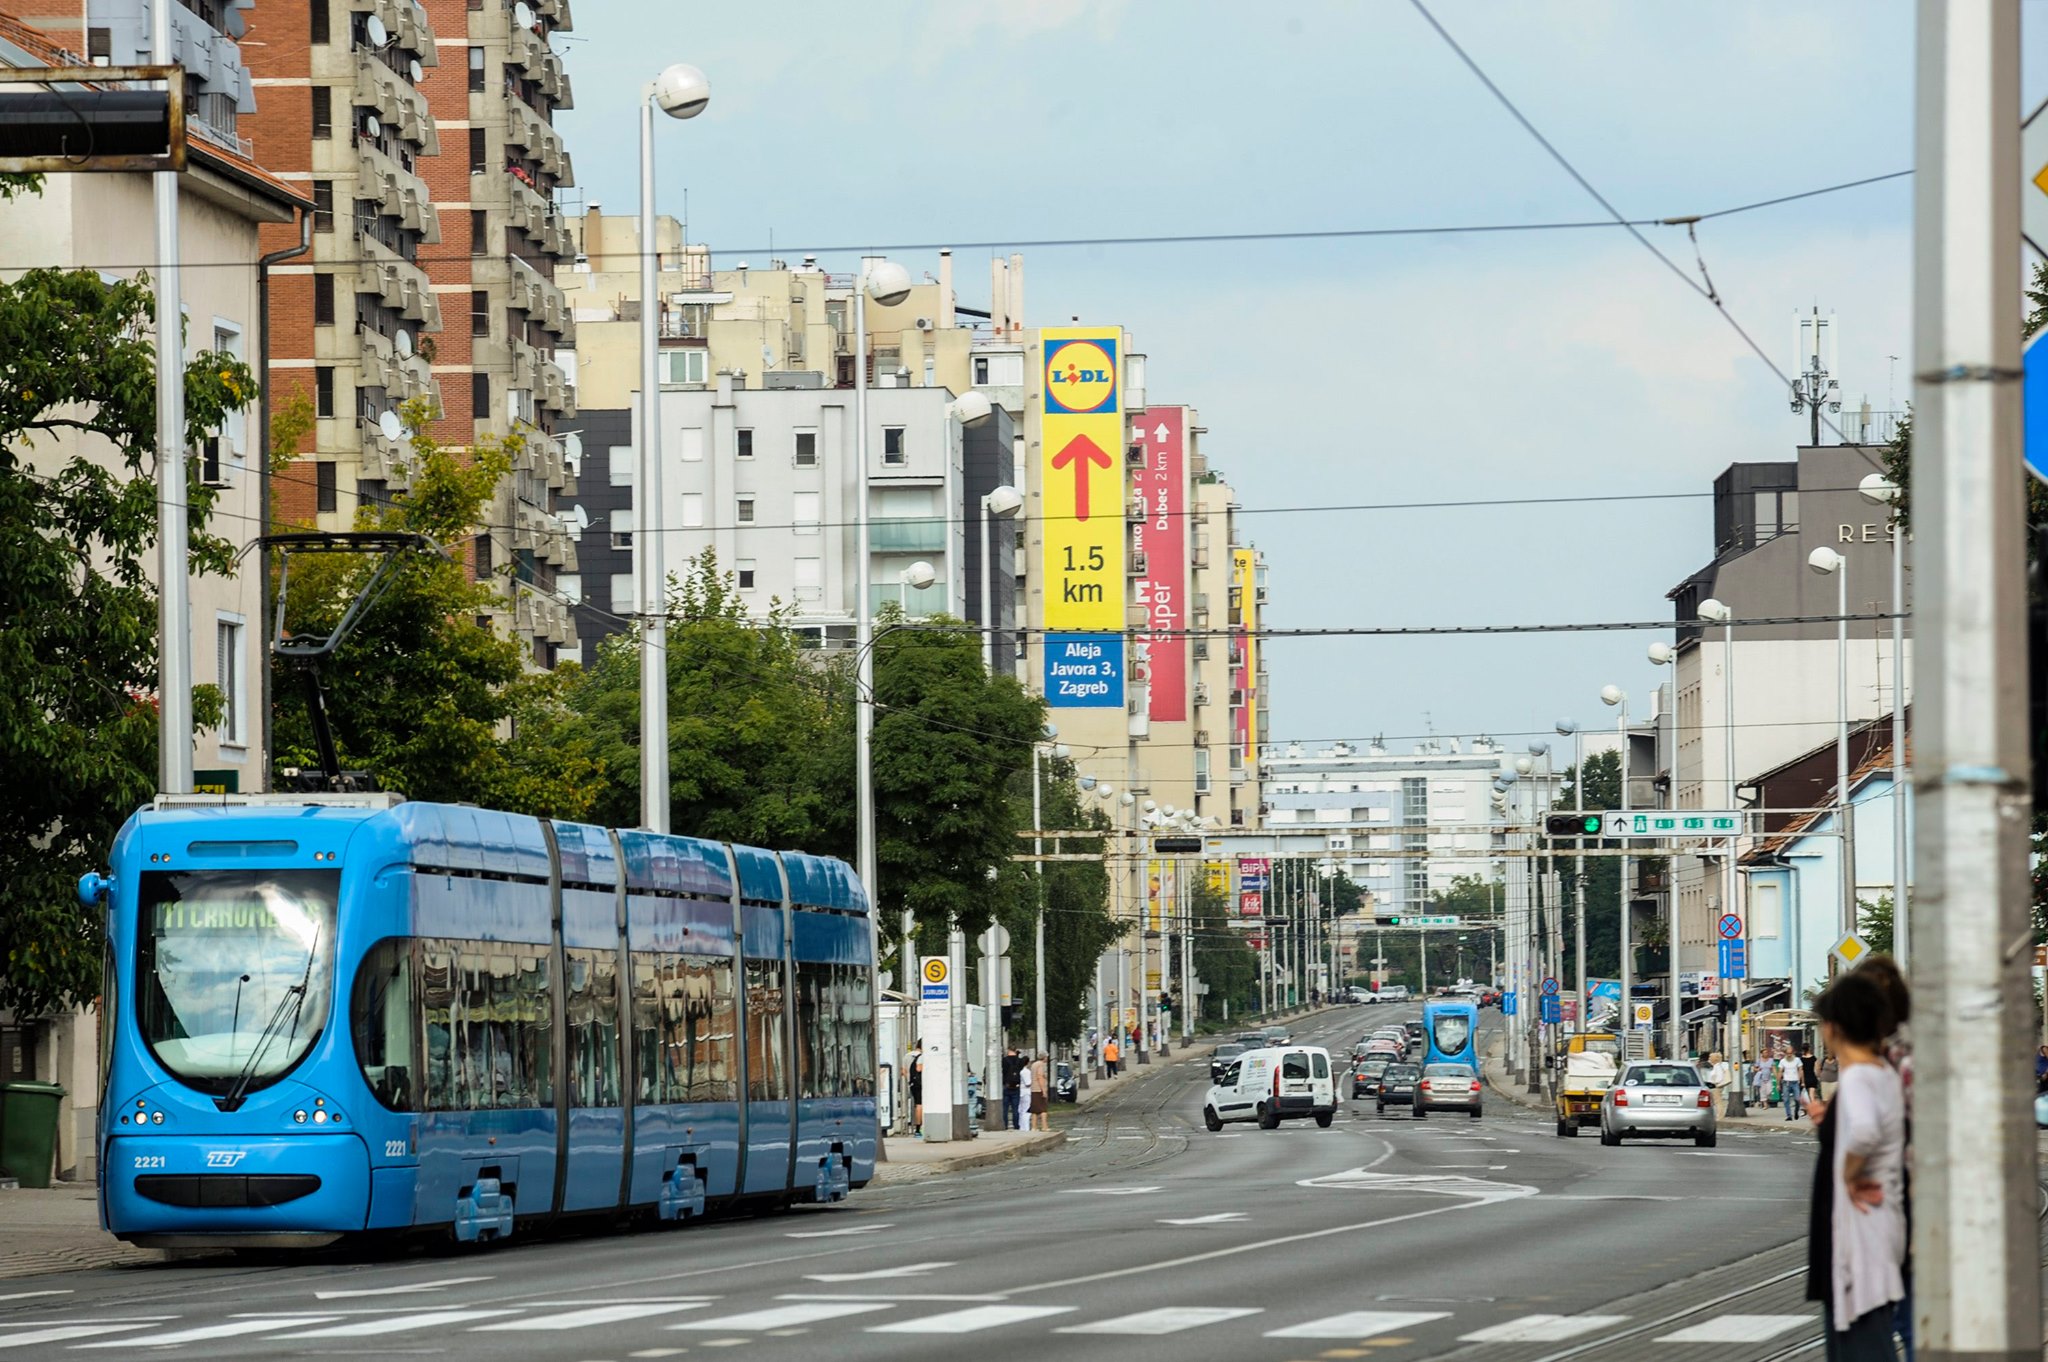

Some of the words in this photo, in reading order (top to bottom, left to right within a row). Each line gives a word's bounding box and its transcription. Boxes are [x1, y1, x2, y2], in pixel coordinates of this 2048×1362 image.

[1154, 452, 1167, 471] km
[1155, 473, 1167, 481] 2
[1155, 488, 1168, 530] Dubec
[1063, 545, 1104, 571] 1.5
[1063, 577, 1103, 603] km
[1154, 581, 1178, 643] super
[1065, 642, 1101, 660] Aleja
[1050, 661, 1097, 676] Javora
[1101, 661, 1116, 677] 3,
[1058, 680, 1108, 698] Zagreb
[384, 1141, 406, 1157] 2221
[134, 1156, 166, 1168] 2221
[207, 1151, 247, 1168] ZET
